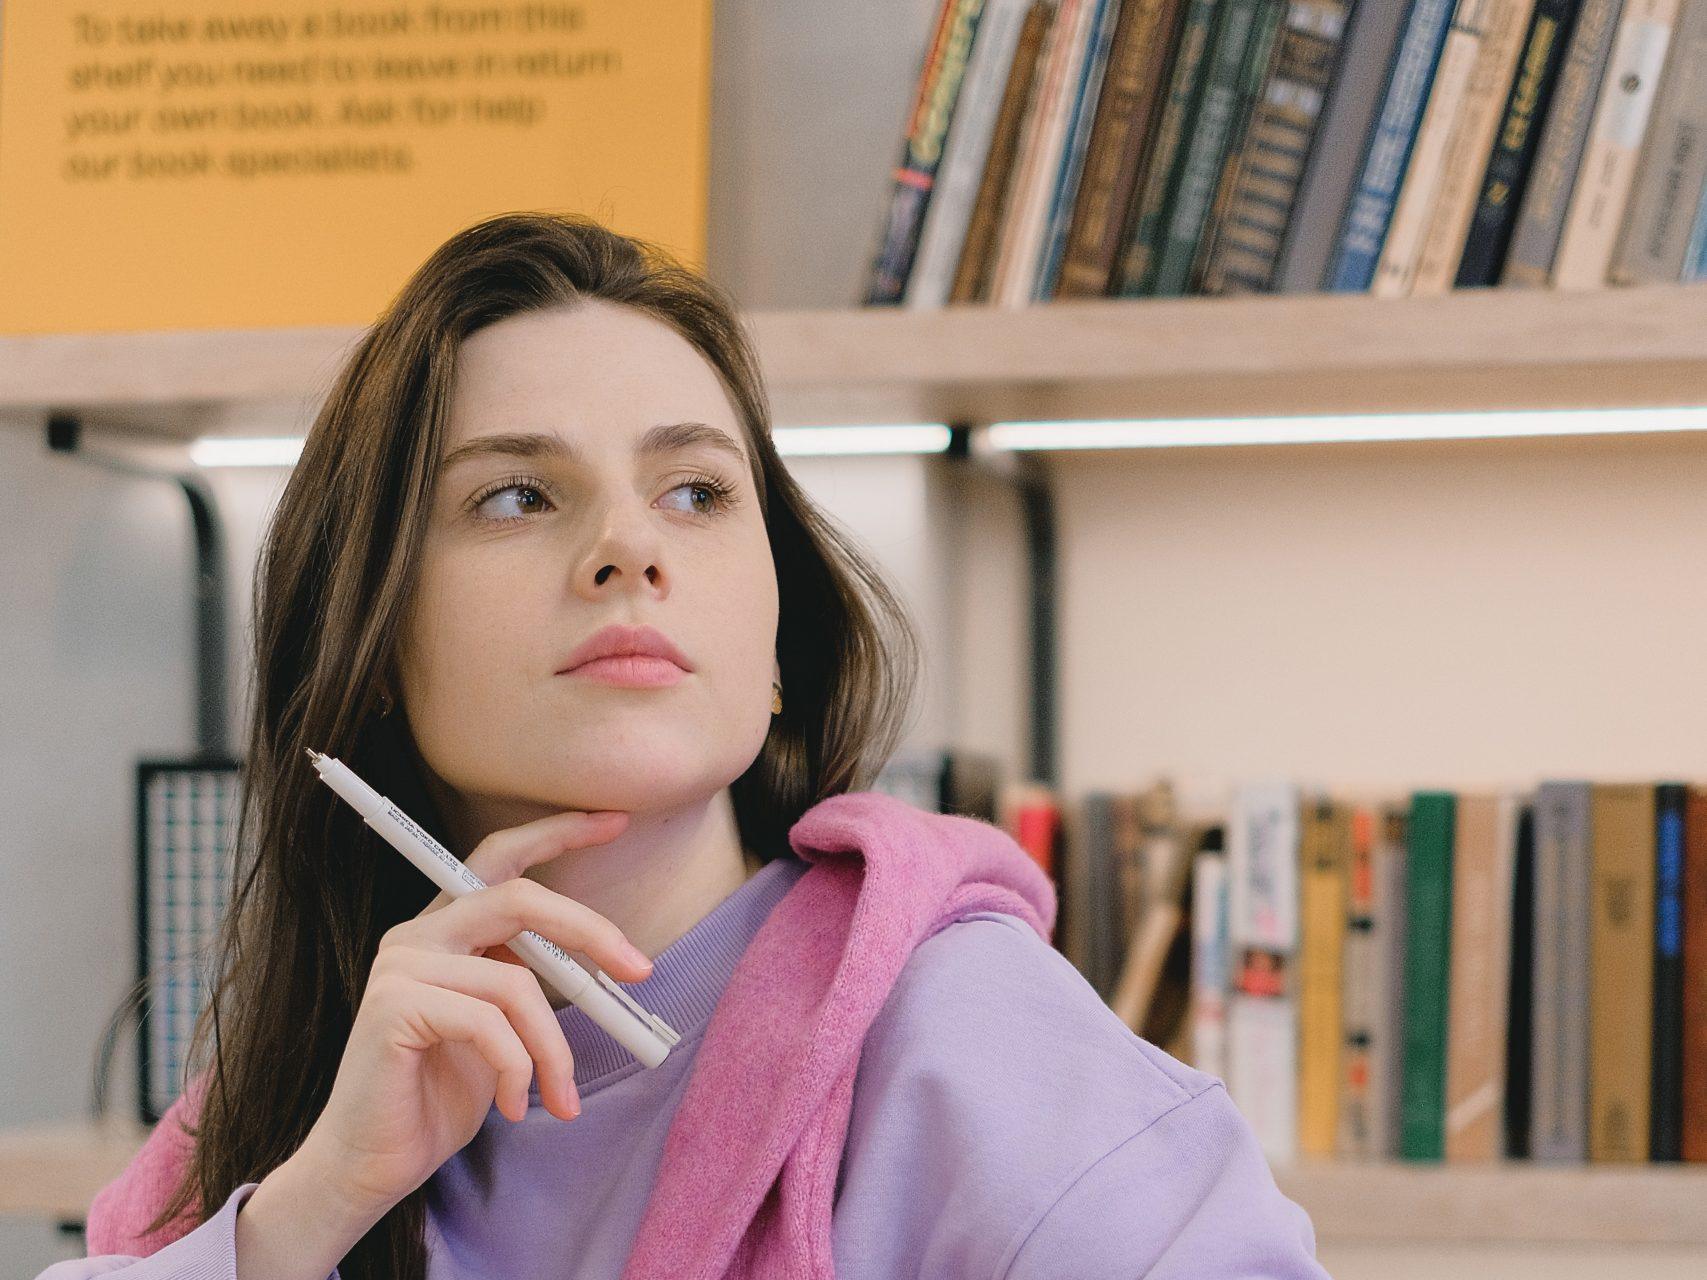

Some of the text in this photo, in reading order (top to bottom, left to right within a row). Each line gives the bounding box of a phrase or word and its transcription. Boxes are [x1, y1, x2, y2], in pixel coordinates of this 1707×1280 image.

[70, 14, 109, 44] To
[203, 15, 288, 46] away
[302, 16, 321, 38] a
[330, 9, 415, 38] book
[423, 7, 507, 35] from
[516, 4, 588, 33] this
[161, 60, 220, 92] you
[331, 54, 361, 82] to
[514, 47, 621, 77] return
[64, 104, 141, 140] your
[154, 104, 220, 133] own
[408, 95, 457, 125] for
[63, 151, 119, 181] our
[127, 145, 213, 179] book
